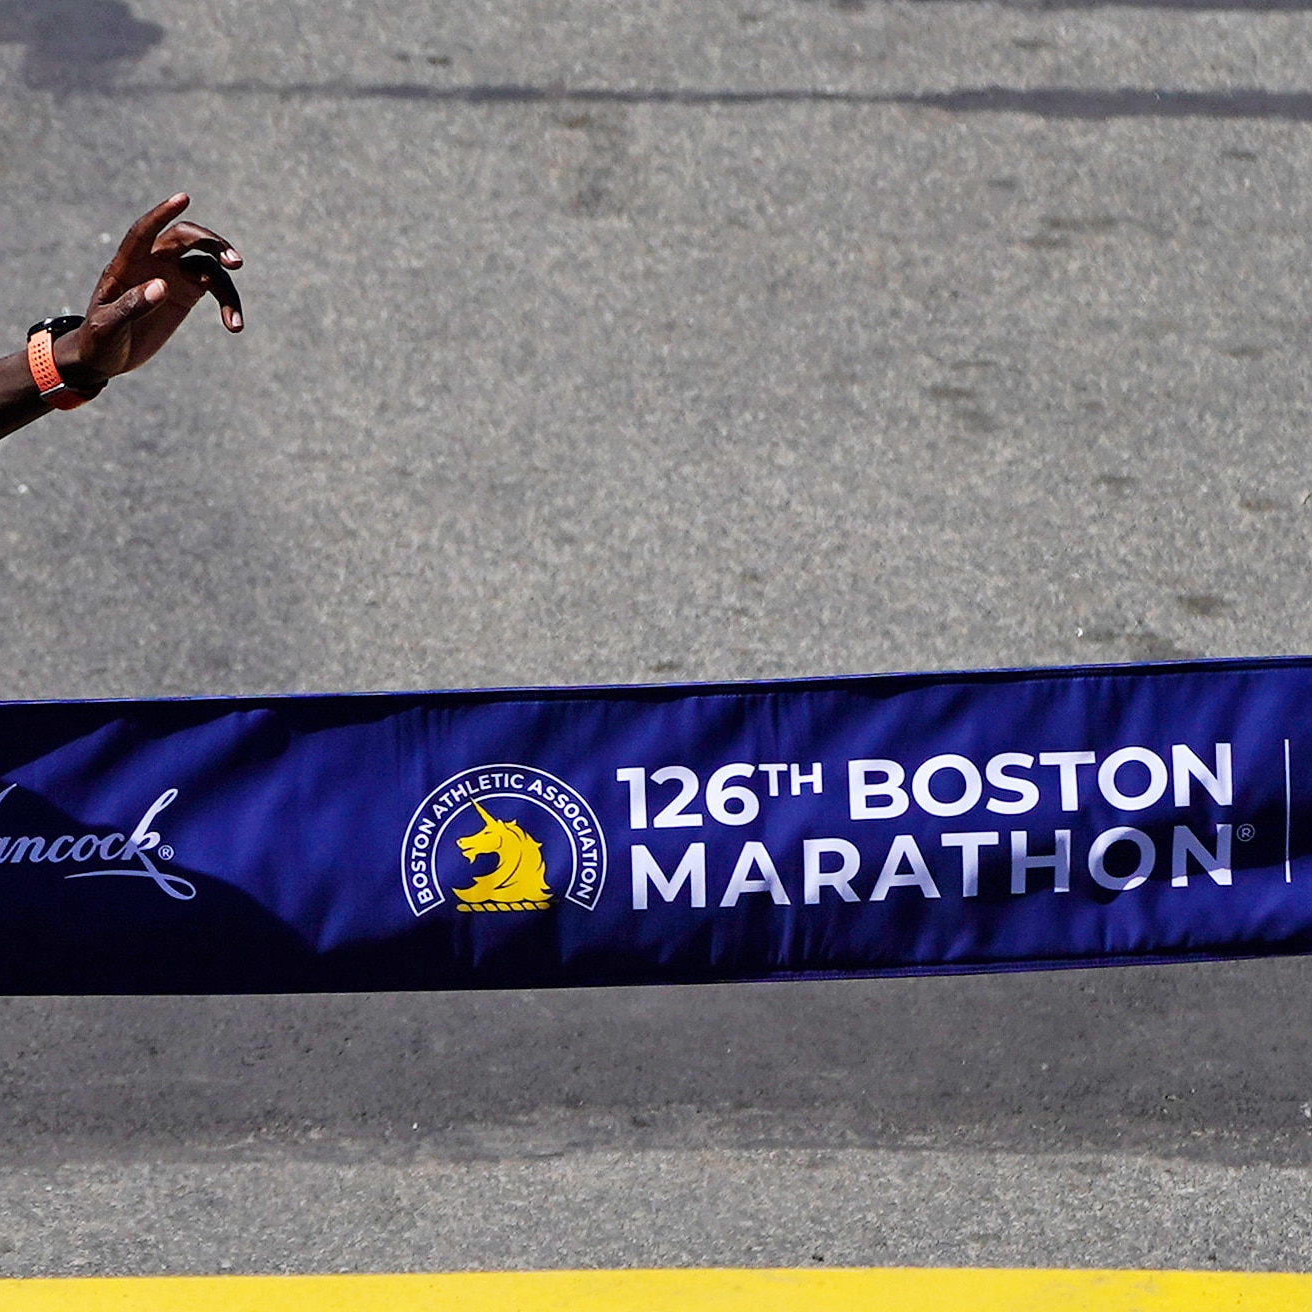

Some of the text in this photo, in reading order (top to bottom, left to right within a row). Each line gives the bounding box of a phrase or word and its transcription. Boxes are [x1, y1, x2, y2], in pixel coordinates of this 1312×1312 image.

[410, 772, 598, 905] BOSTON ATHLETIC ASSOCIATION
[616, 742, 1233, 830] 126TH BOSTON
